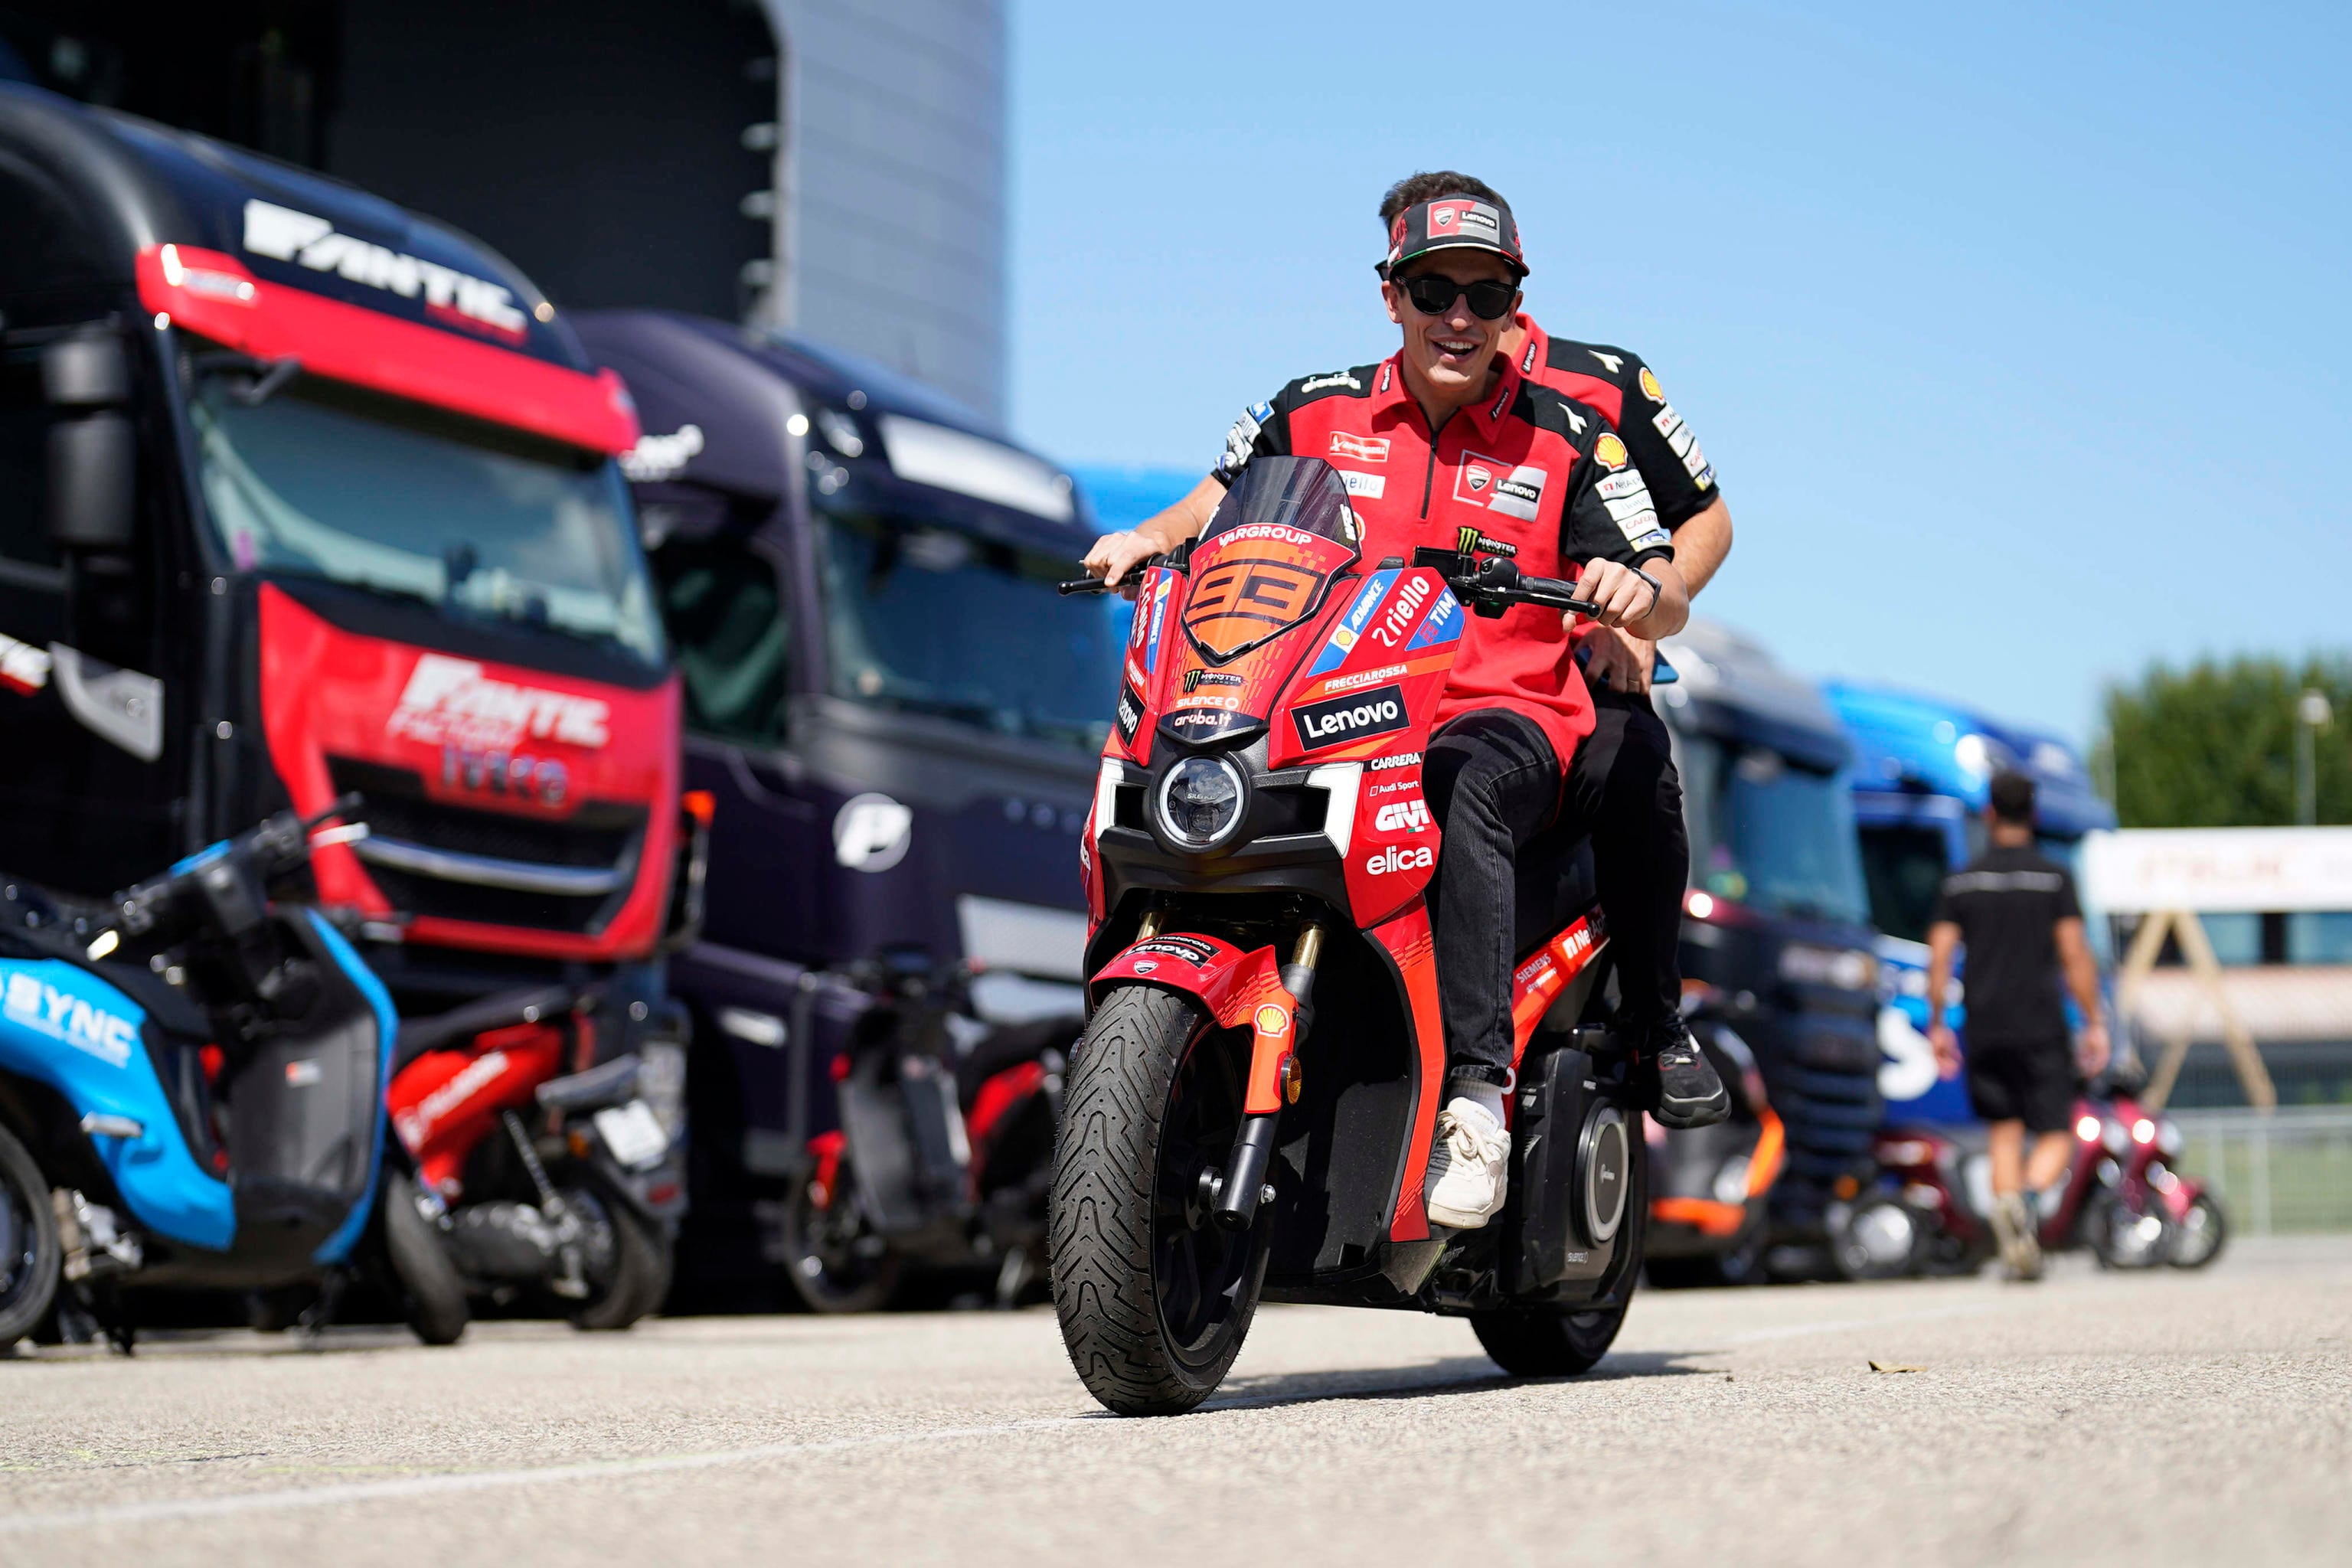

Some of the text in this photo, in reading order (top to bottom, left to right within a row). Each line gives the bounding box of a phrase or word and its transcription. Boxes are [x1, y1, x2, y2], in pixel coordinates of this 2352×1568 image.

[1462, 211, 1495, 228] Lenovo
[243, 198, 528, 334] FANTIC
[1344, 474, 1377, 492] iello
[1497, 479, 1537, 499] Lenovo
[1219, 526, 1312, 547] VARGROUP
[1477, 537, 1517, 554] MONSTER
[1184, 560, 1321, 624] 93
[1351, 578, 1385, 632] ADVANCE
[1387, 576, 1430, 636] riello
[1429, 592, 1457, 626] TIM
[1200, 672, 1242, 683] MONSTER
[1325, 664, 1408, 692] FRECCIAROSSA
[403, 652, 611, 748] FANTIC
[1176, 695, 1223, 708] SILENCE
[1174, 709, 1232, 727] aruba.it
[1303, 700, 1399, 739] Lenovo
[1370, 752, 1422, 771] CARRERA
[1379, 780, 1419, 794] Audi Sport
[1375, 799, 1431, 832] GIVI
[1366, 844, 1434, 876] elica
[1124, 942, 1200, 962] Lenovo
[1516, 952, 1552, 984] SIEMENS
